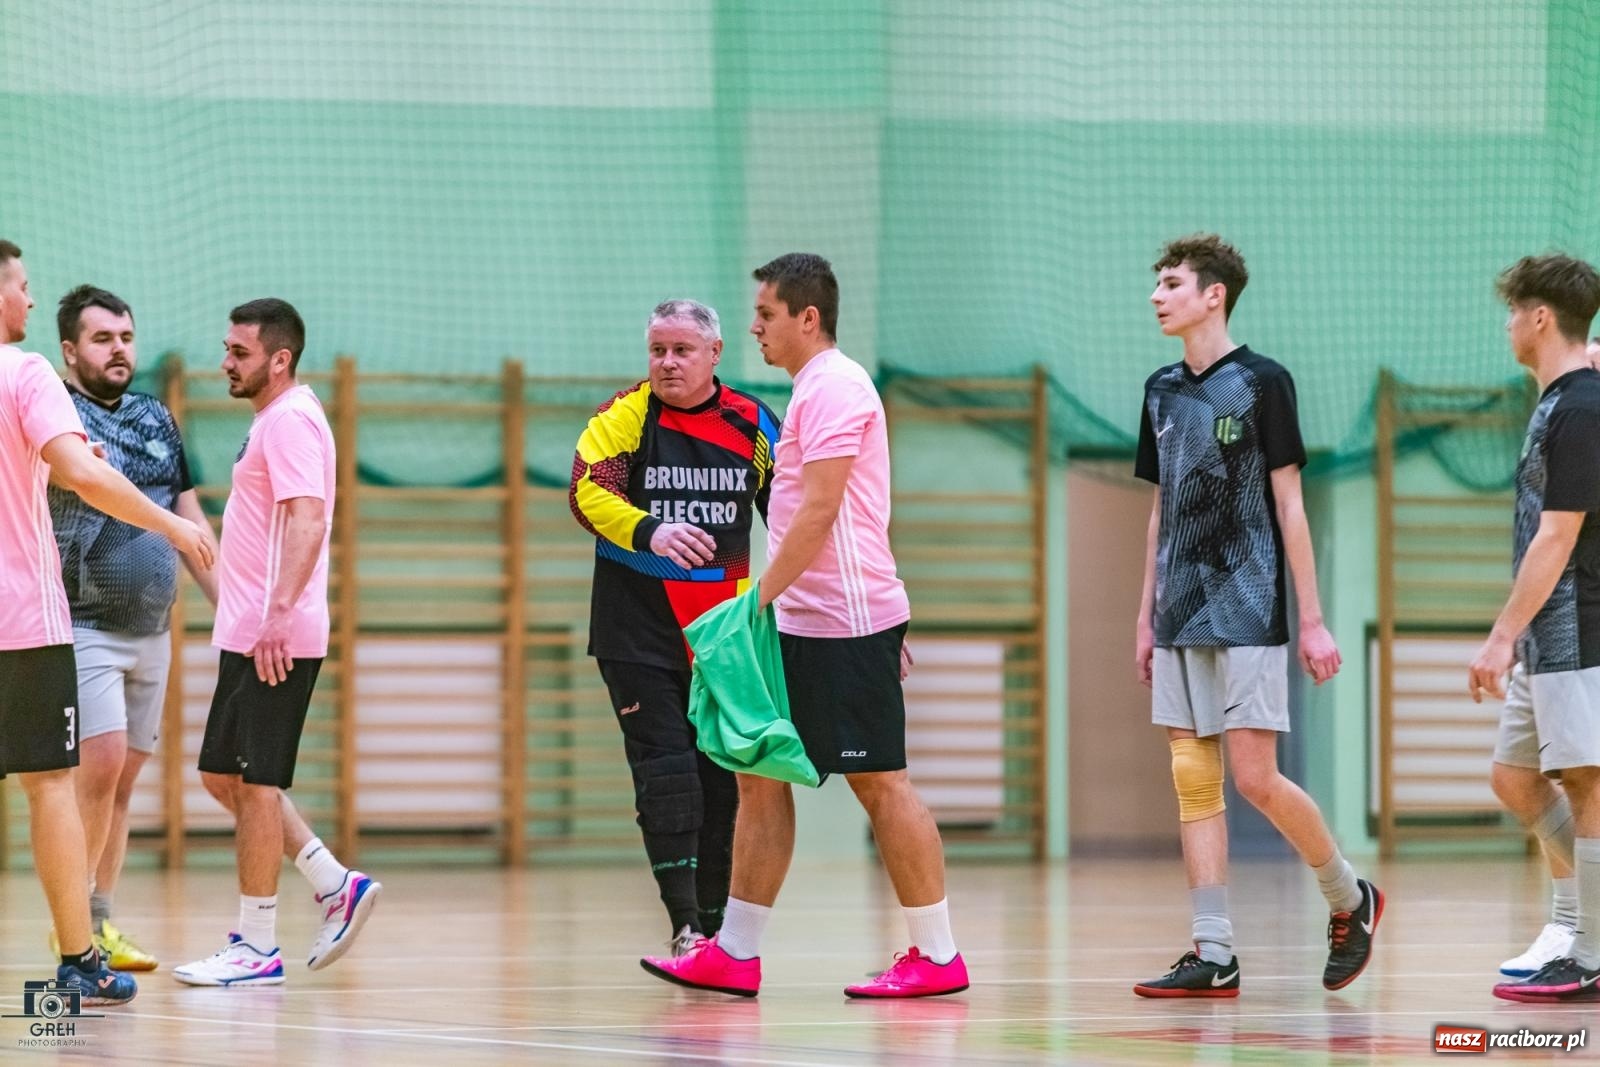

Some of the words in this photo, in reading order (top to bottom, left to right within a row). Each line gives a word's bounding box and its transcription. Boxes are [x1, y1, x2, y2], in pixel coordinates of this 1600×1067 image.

[644, 466, 748, 491] BRUININX
[650, 500, 738, 524] ELECTRO
[64, 706, 75, 751] 3
